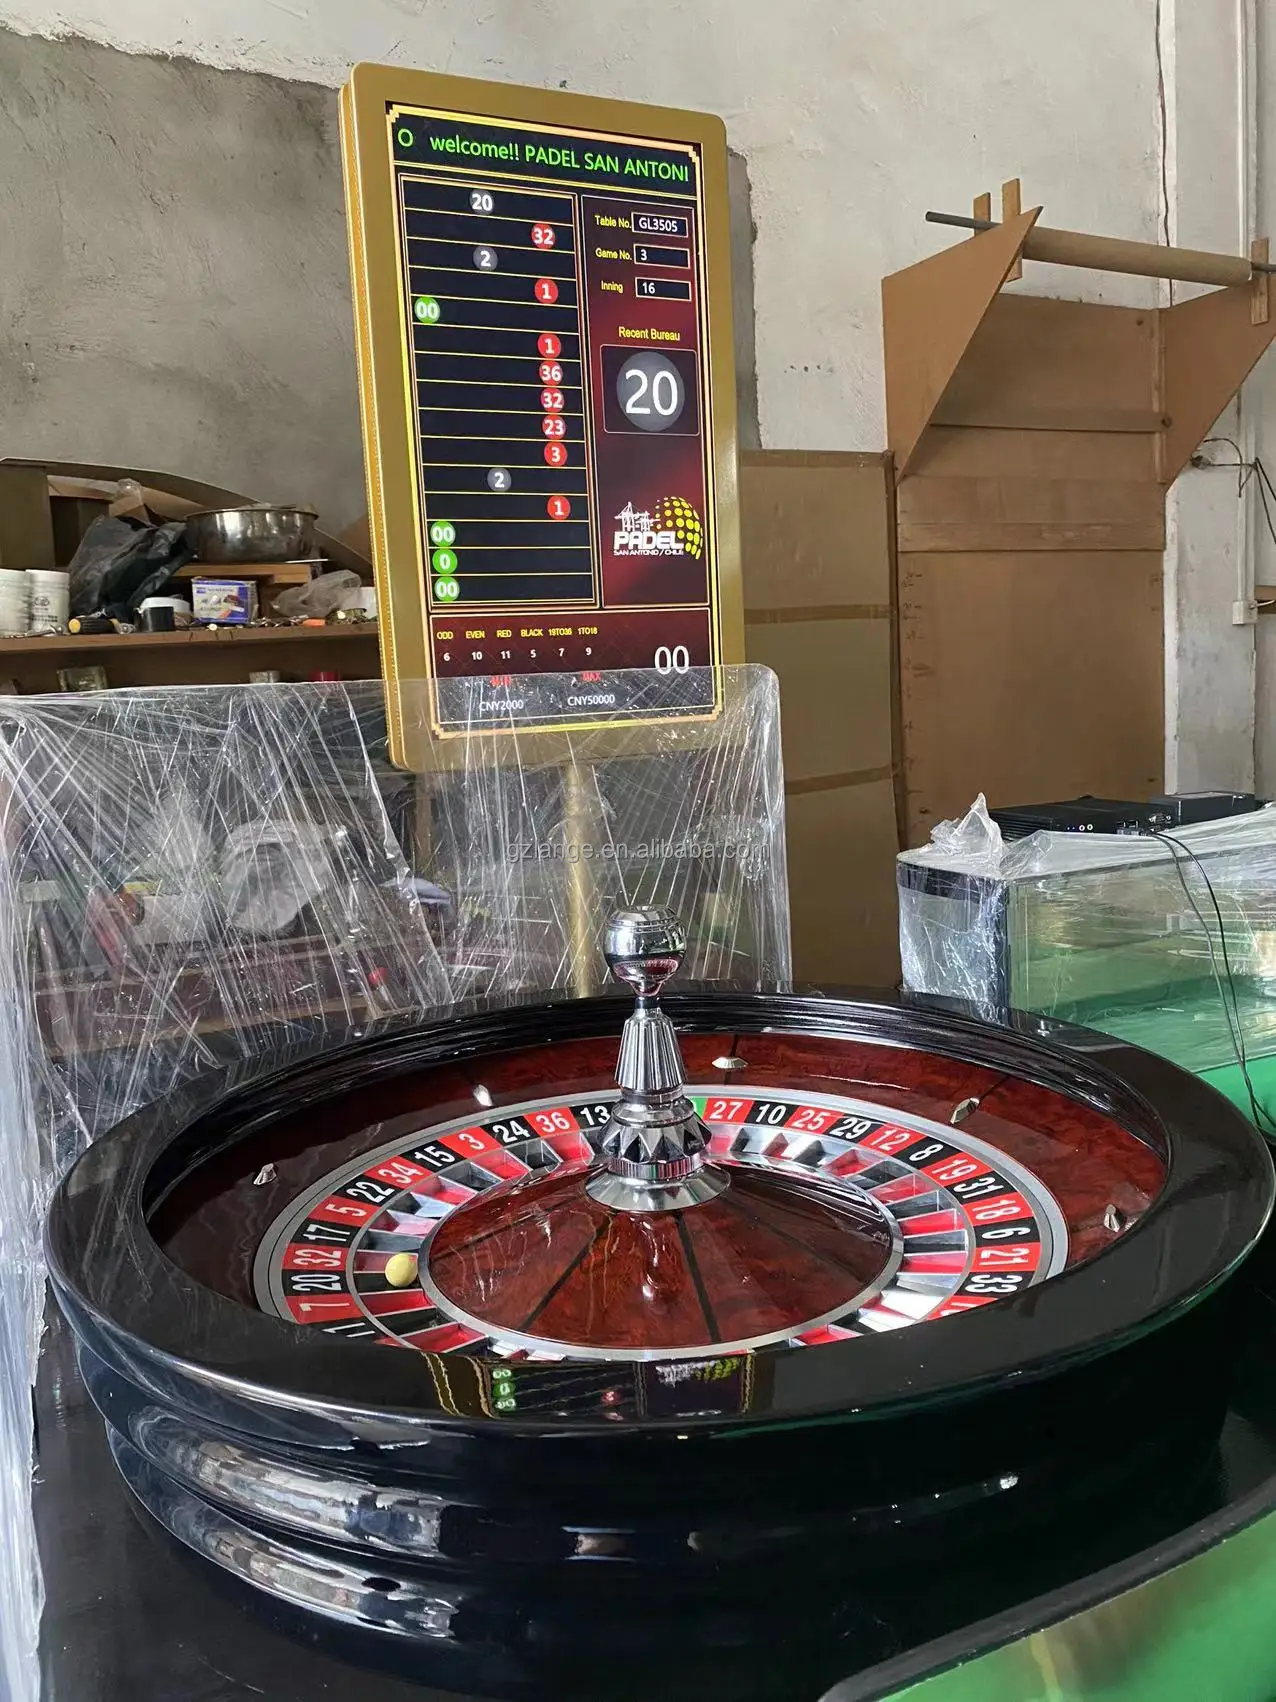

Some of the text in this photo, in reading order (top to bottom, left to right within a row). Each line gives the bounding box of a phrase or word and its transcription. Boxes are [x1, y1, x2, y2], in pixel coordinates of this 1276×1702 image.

[430, 135, 519, 161] welcome!!
[525, 145, 580, 169] PADEL
[584, 153, 619, 173] SAN
[624, 162, 689, 182] ANTONI
[471, 193, 493, 211] 20
[595, 215, 631, 229] Table No.
[639, 217, 678, 232] GL3505
[534, 228, 554, 245] 32
[481, 251, 491, 266] 2
[595, 248, 632, 261] Game No.
[640, 249, 647, 261] 3
[542, 284, 551, 298] 1
[601, 281, 623, 293] Inning
[642, 282, 655, 294] 16
[416, 302, 438, 318] 00
[619, 326, 680, 341] Recent Bureau
[545, 339, 553, 353] 1
[541, 365, 562, 380] 36
[543, 393, 564, 408] 32
[625, 369, 677, 416] 20
[544, 420, 564, 435] 23
[551, 447, 560, 462] 3
[494, 473, 505, 487] 2
[554, 501, 563, 515] 1
[432, 527, 454, 542] 00
[614, 531, 684, 549] PADEL
[440, 554, 450, 568] 0
[436, 582, 459, 597] 00
[437, 627, 598, 640] ODD EVEN RED BLACK 19TO36 1TO18
[443, 652, 450, 661] 6
[472, 652, 482, 660] 10
[501, 651, 510, 659] 11
[530, 650, 536, 658] 5
[559, 648, 564, 656] 7
[654, 645, 689, 675] 00
[568, 694, 615, 706] CNY50000
[580, 1105, 611, 1126] 13
[710, 1101, 744, 1120] 27
[756, 1104, 786, 1124] 10
[536, 1111, 571, 1133] 36
[797, 1110, 825, 1131] 25
[837, 1118, 872, 1140] 29
[492, 1120, 529, 1143] 24
[878, 1128, 911, 1151] 12
[458, 1133, 486, 1152] 3
[414, 1146, 456, 1168] 15
[909, 1143, 944, 1161] 8
[378, 1161, 423, 1184] 34
[932, 1159, 978, 1181] 19
[347, 1181, 393, 1204] 22
[953, 1177, 1004, 1199] 31
[325, 1204, 367, 1218] 5
[973, 1199, 1021, 1221] 18
[303, 1223, 351, 1243] 17
[980, 1227, 1030, 1240] 6
[294, 1248, 342, 1268] 32
[979, 1248, 1030, 1267] 21
[292, 1274, 342, 1292] 20
[965, 1274, 1023, 1294] 33
